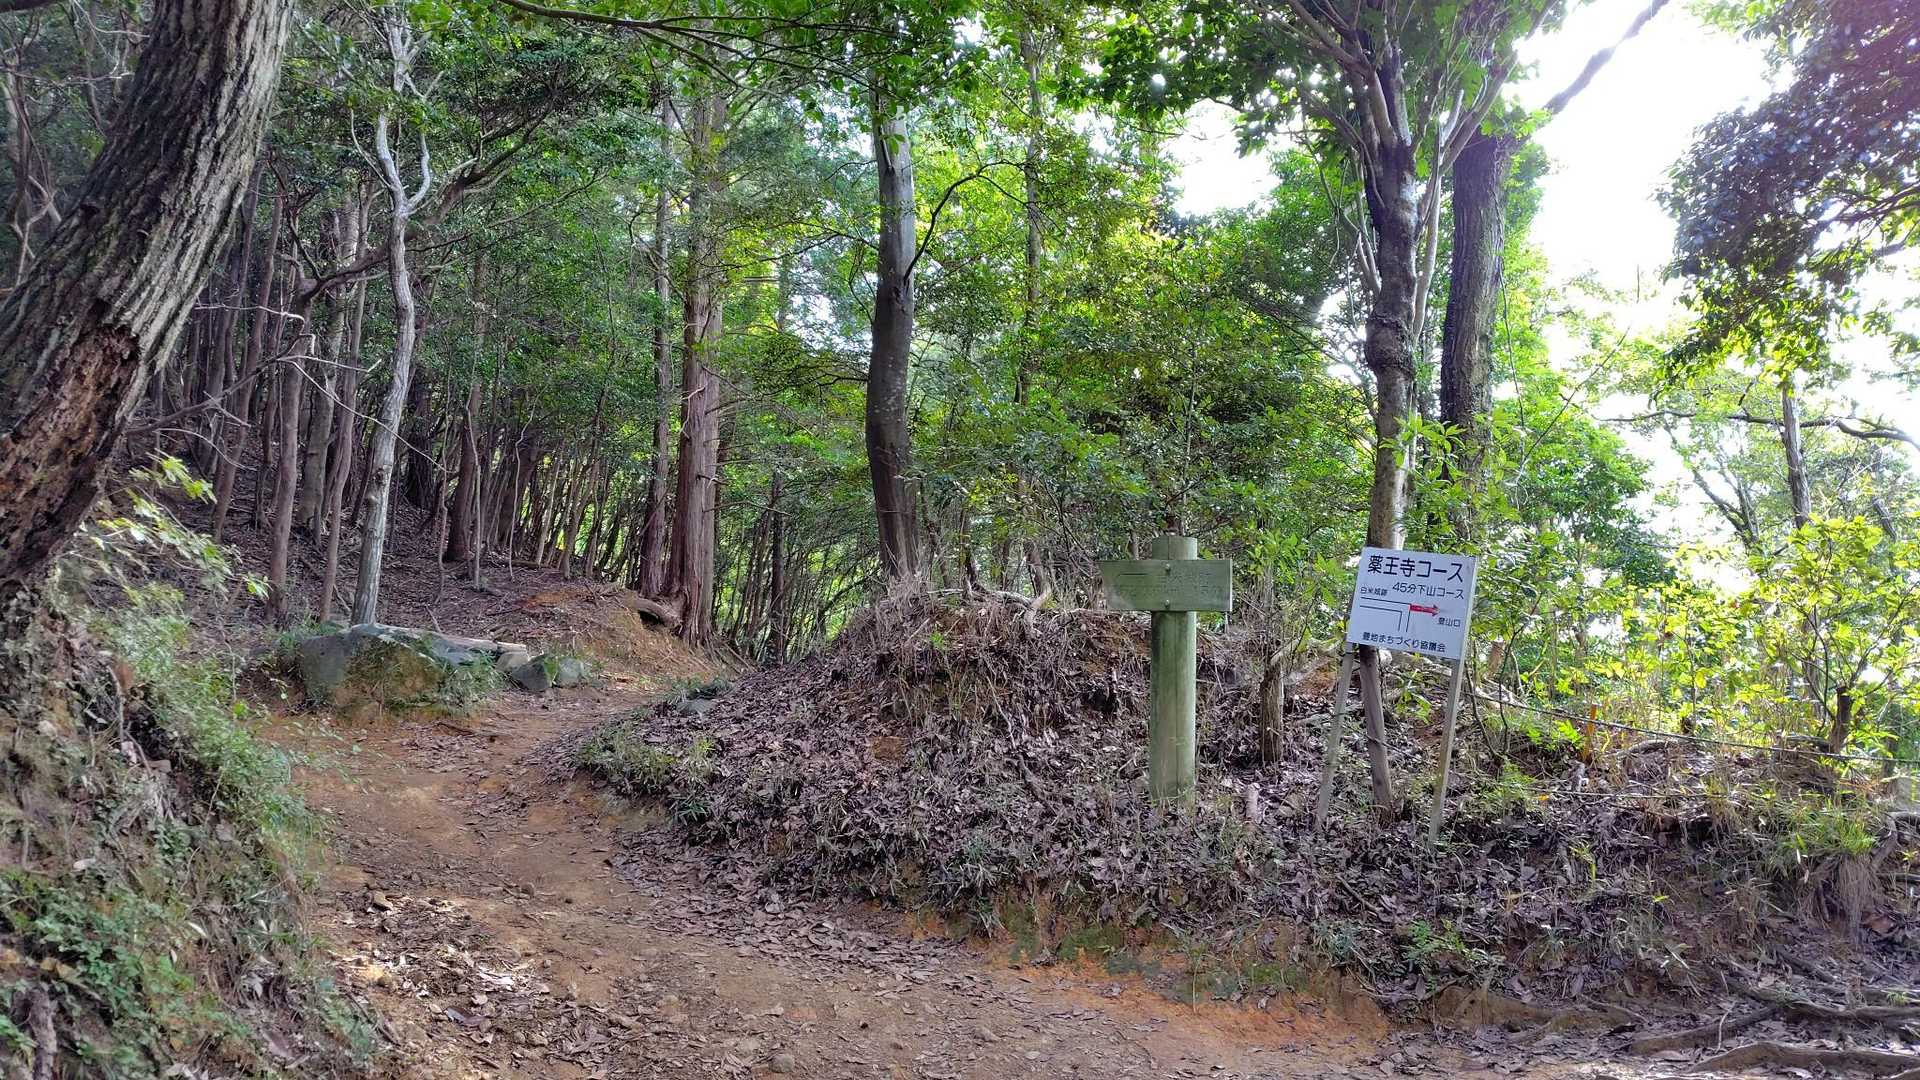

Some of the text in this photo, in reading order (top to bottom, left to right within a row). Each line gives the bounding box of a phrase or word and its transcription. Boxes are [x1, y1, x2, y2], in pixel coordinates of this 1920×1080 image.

[1367, 555, 1463, 582] 薬王寺コース
[1392, 582, 1464, 599] 45分下山コース
[1437, 617, 1461, 628] 登山口
